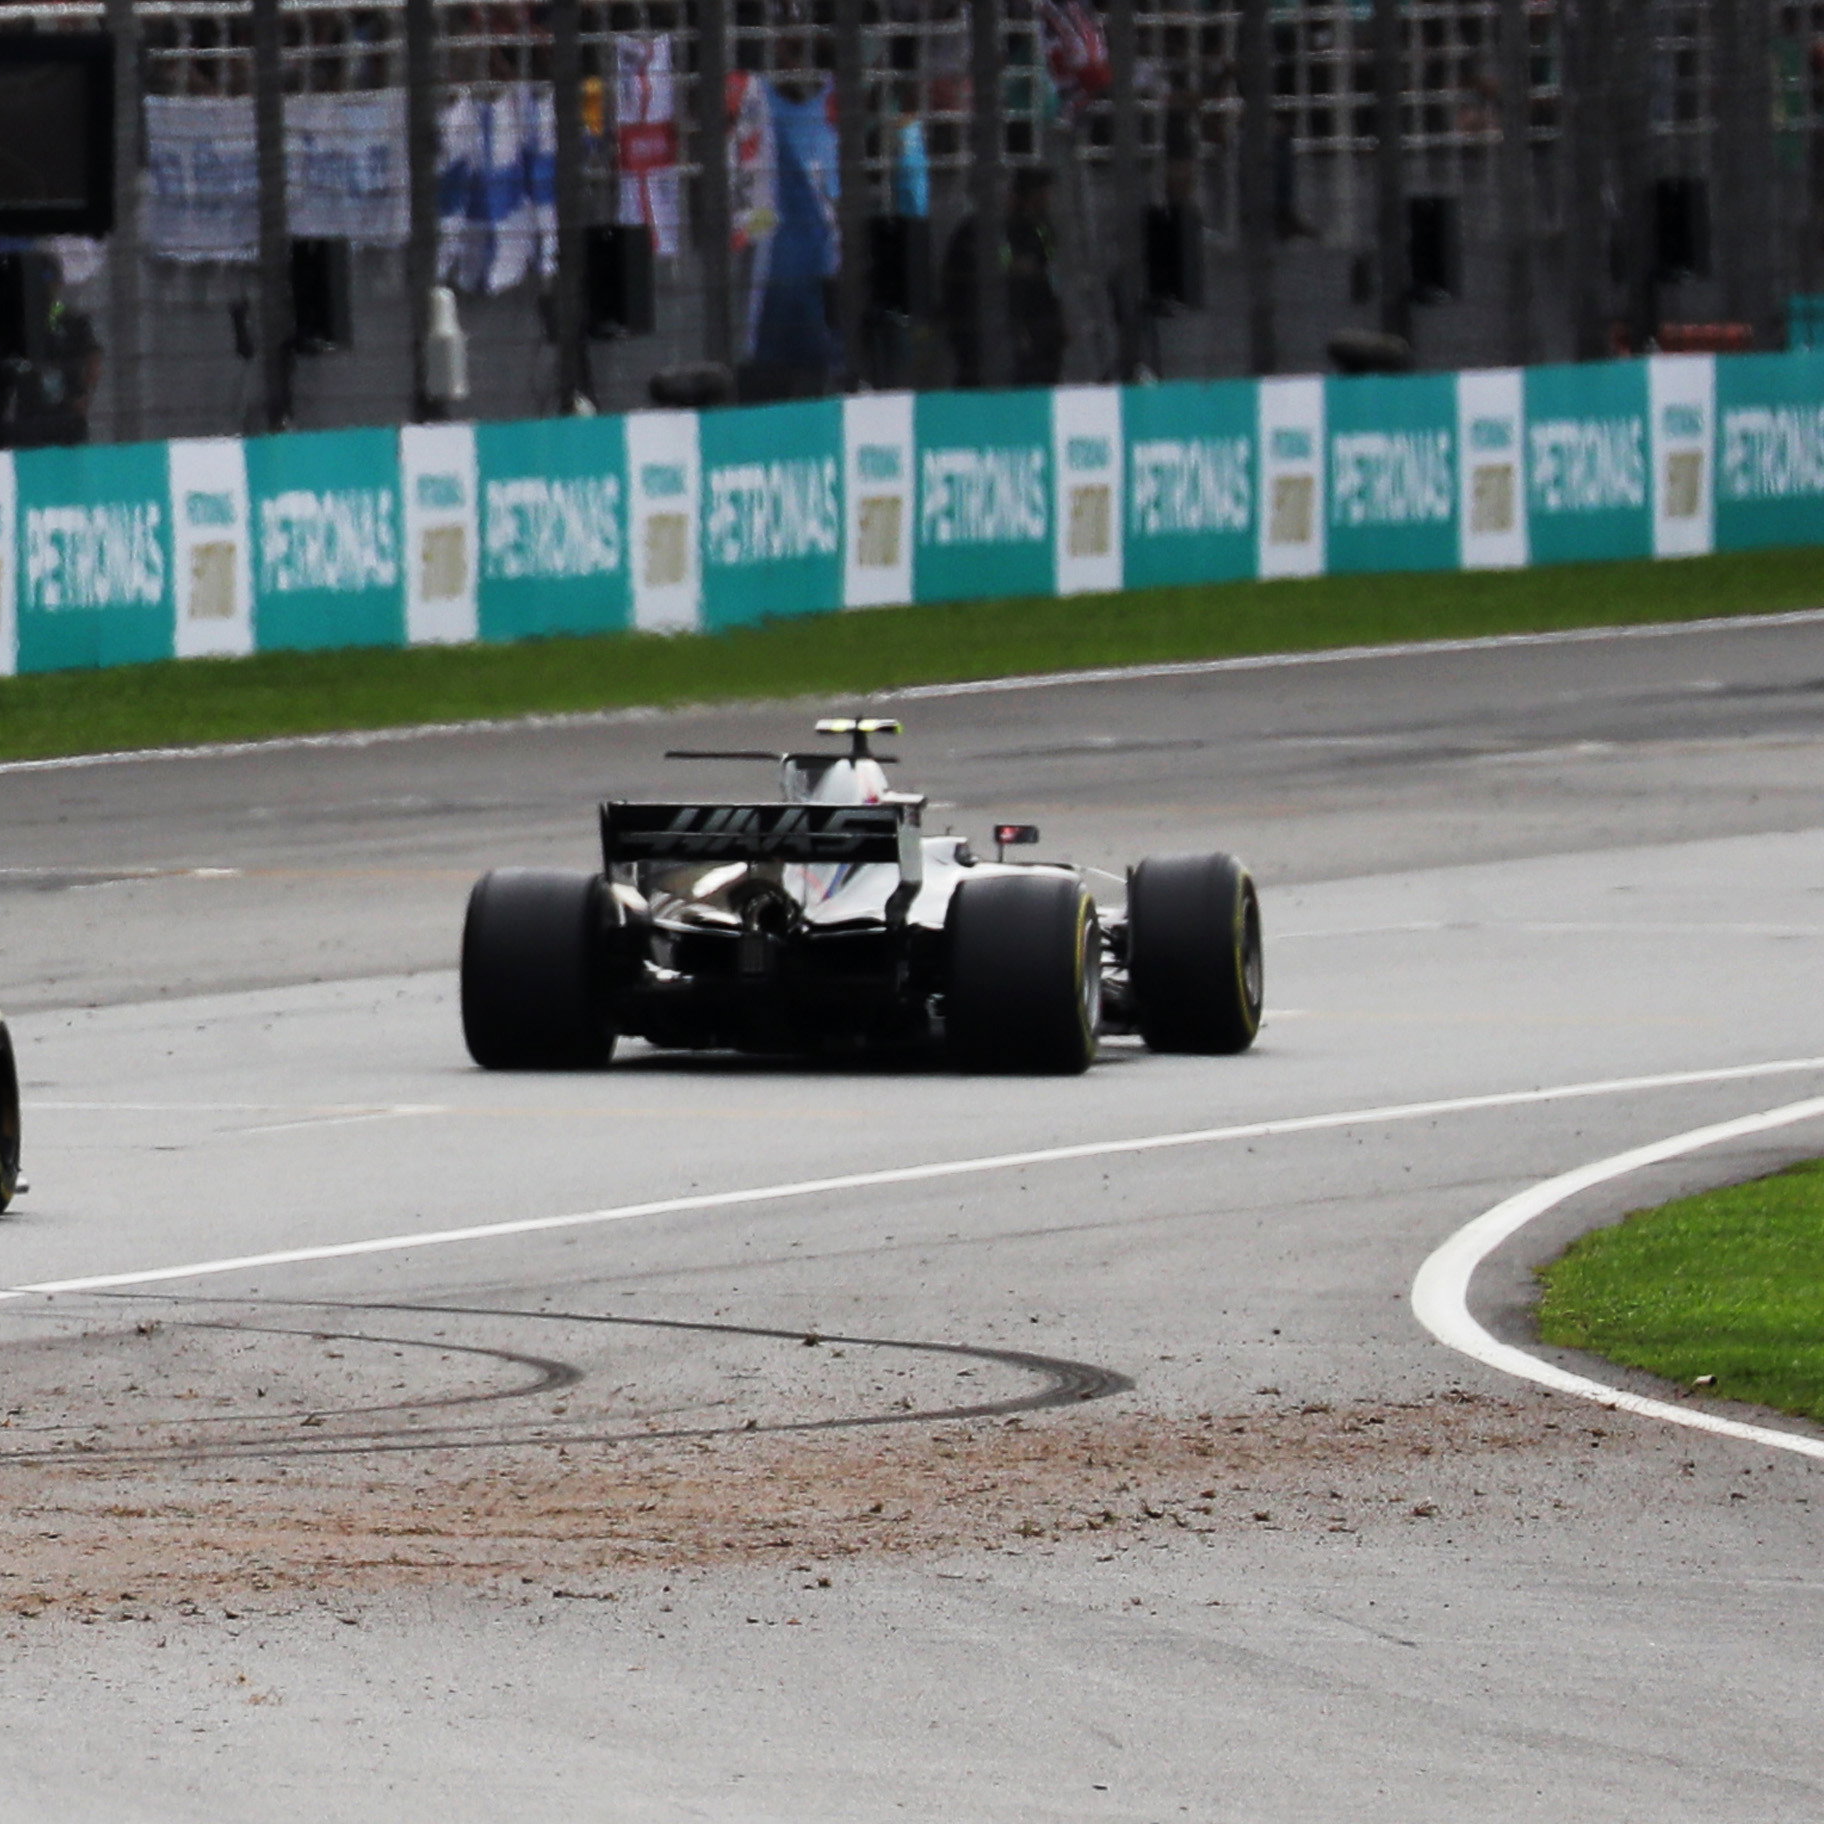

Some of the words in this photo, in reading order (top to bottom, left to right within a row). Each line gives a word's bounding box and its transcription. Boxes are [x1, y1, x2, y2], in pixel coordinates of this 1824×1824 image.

[27, 501, 163, 610] PETRONAS
[261, 487, 395, 592] PETRONAS
[485, 475, 620, 578] PETRONAS
[619, 807, 901, 854] HAAS
